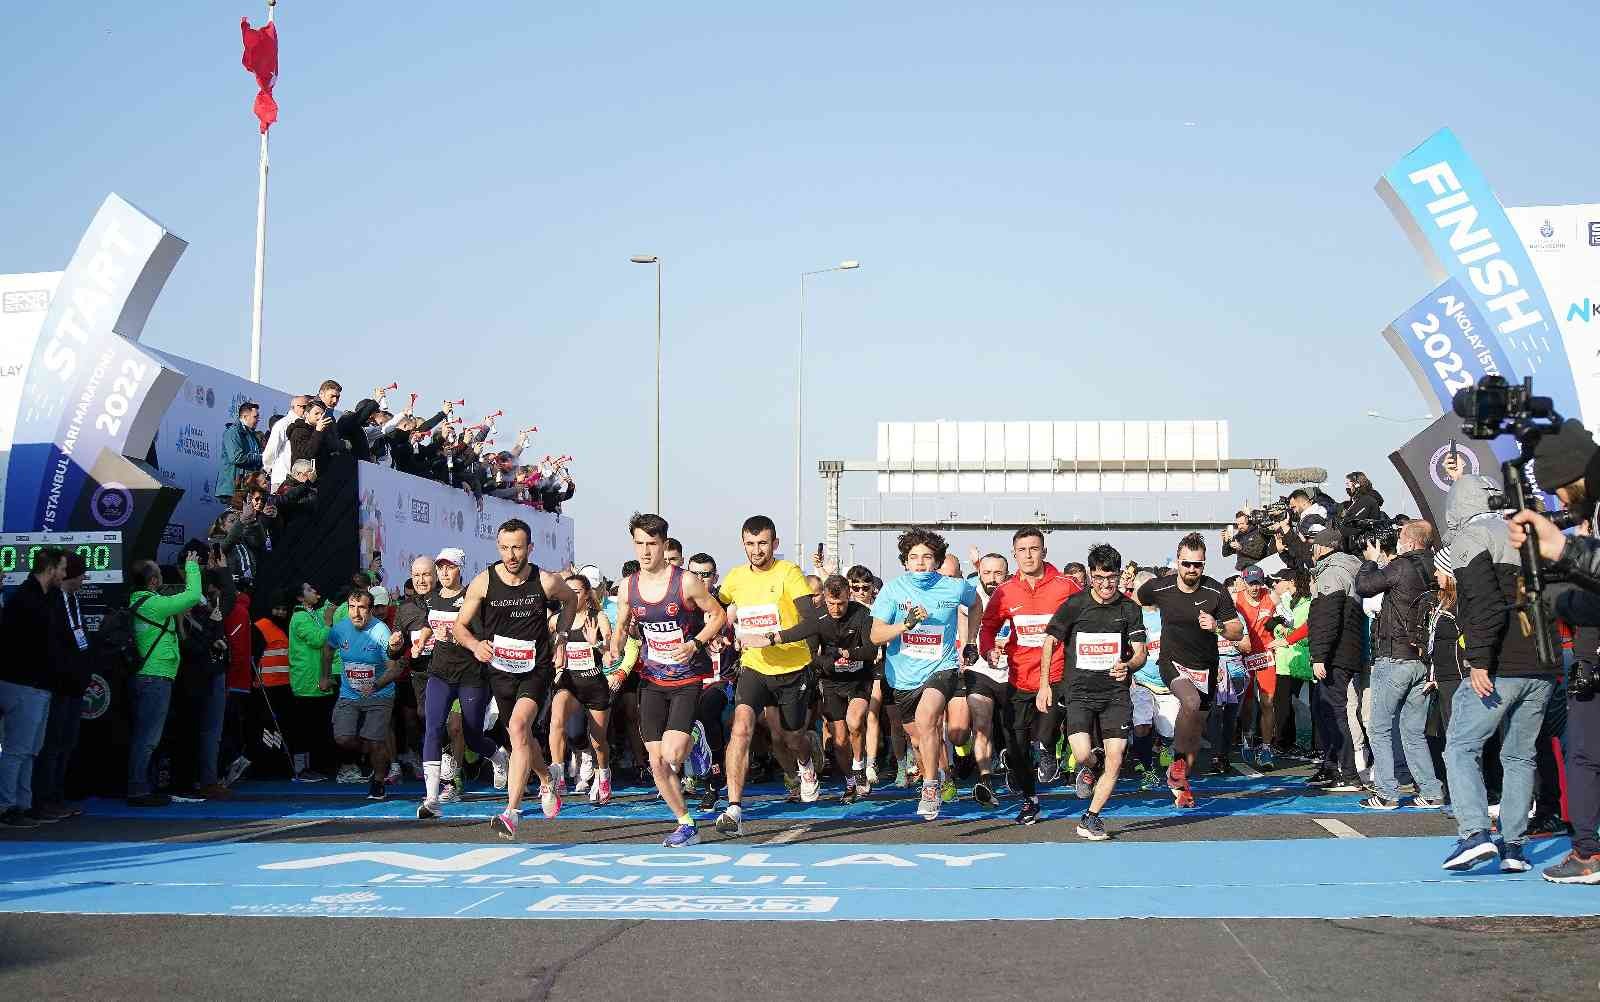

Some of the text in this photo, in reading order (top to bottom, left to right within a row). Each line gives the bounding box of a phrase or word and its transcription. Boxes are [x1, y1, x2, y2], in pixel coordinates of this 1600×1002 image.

[1408, 160, 1543, 334] FINISH
[43, 218, 138, 383] START
[1410, 312, 1475, 399] 2022
[61, 423, 82, 455] YARI
[95, 359, 145, 437] 2022
[559, 896, 813, 905] SPOR
